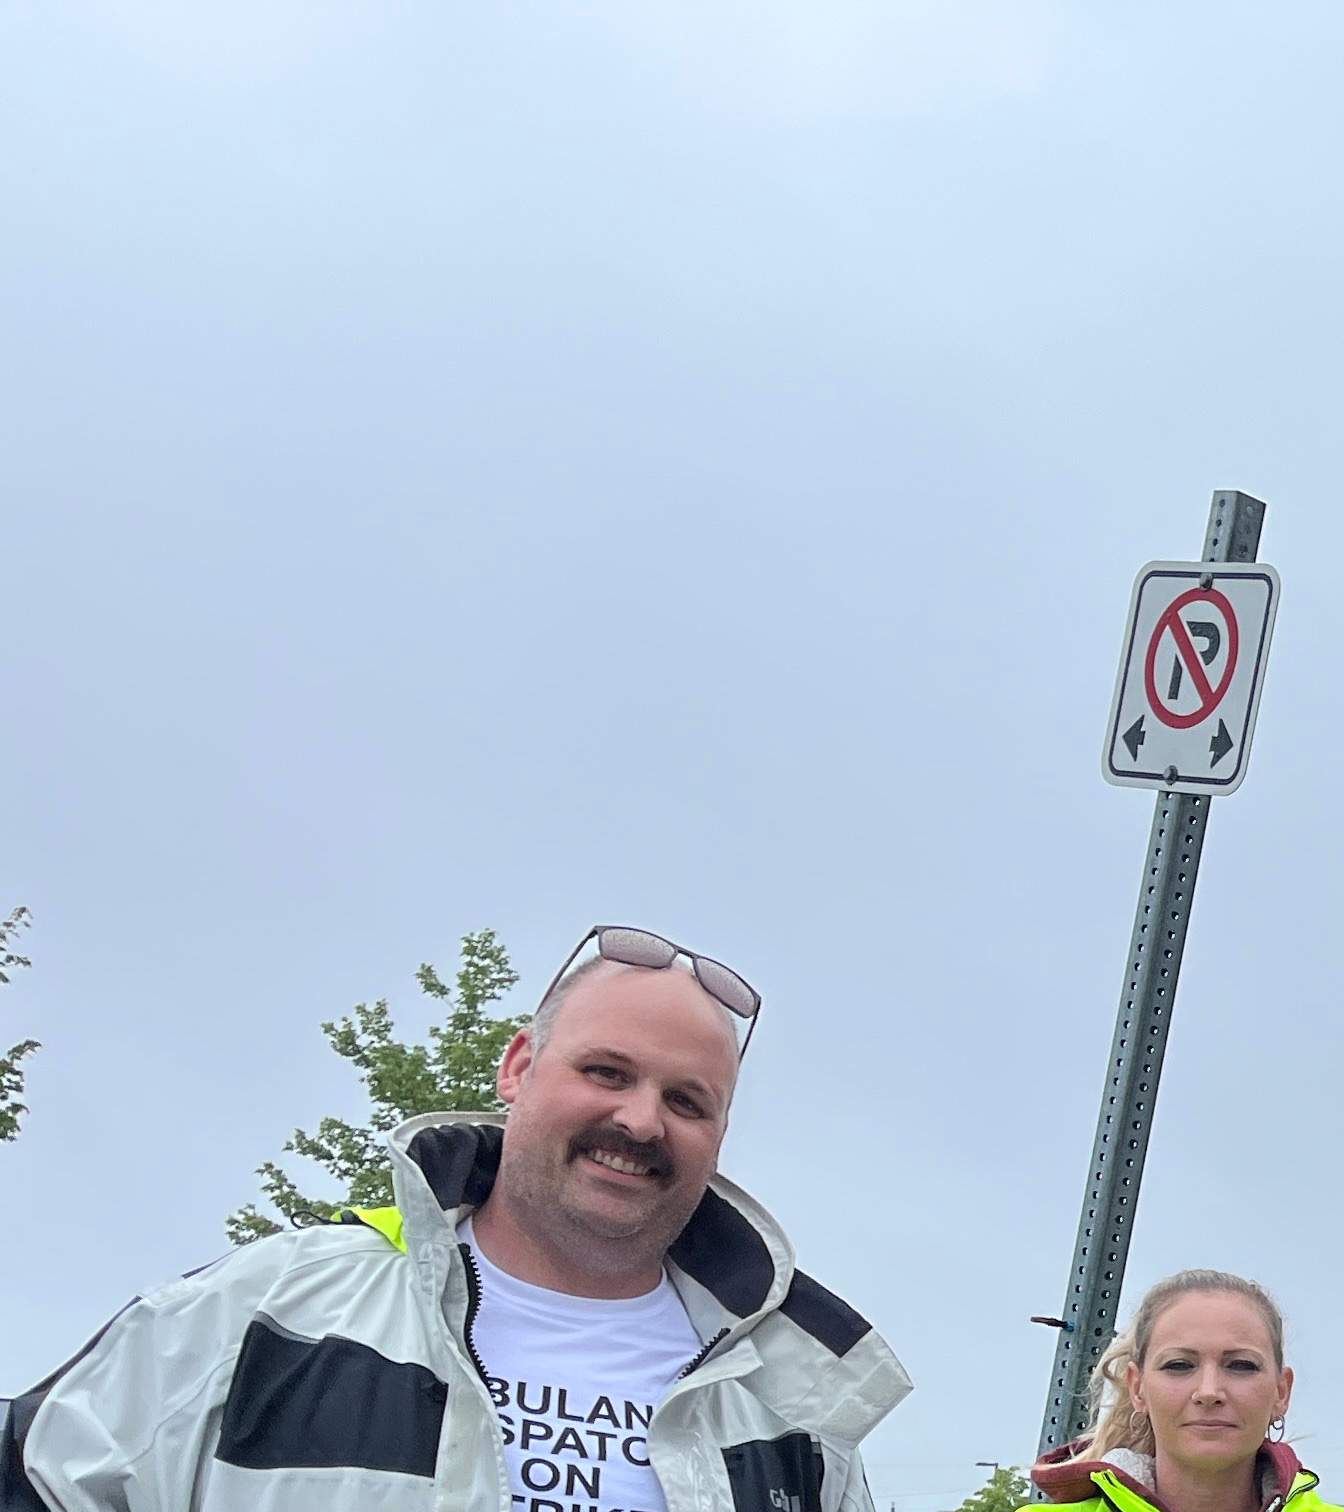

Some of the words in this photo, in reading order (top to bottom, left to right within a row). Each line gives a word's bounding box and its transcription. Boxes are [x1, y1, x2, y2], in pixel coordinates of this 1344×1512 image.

[489, 1376, 652, 1429] BULAN
[502, 1414, 651, 1467] SPATC
[521, 1458, 601, 1499] ON
